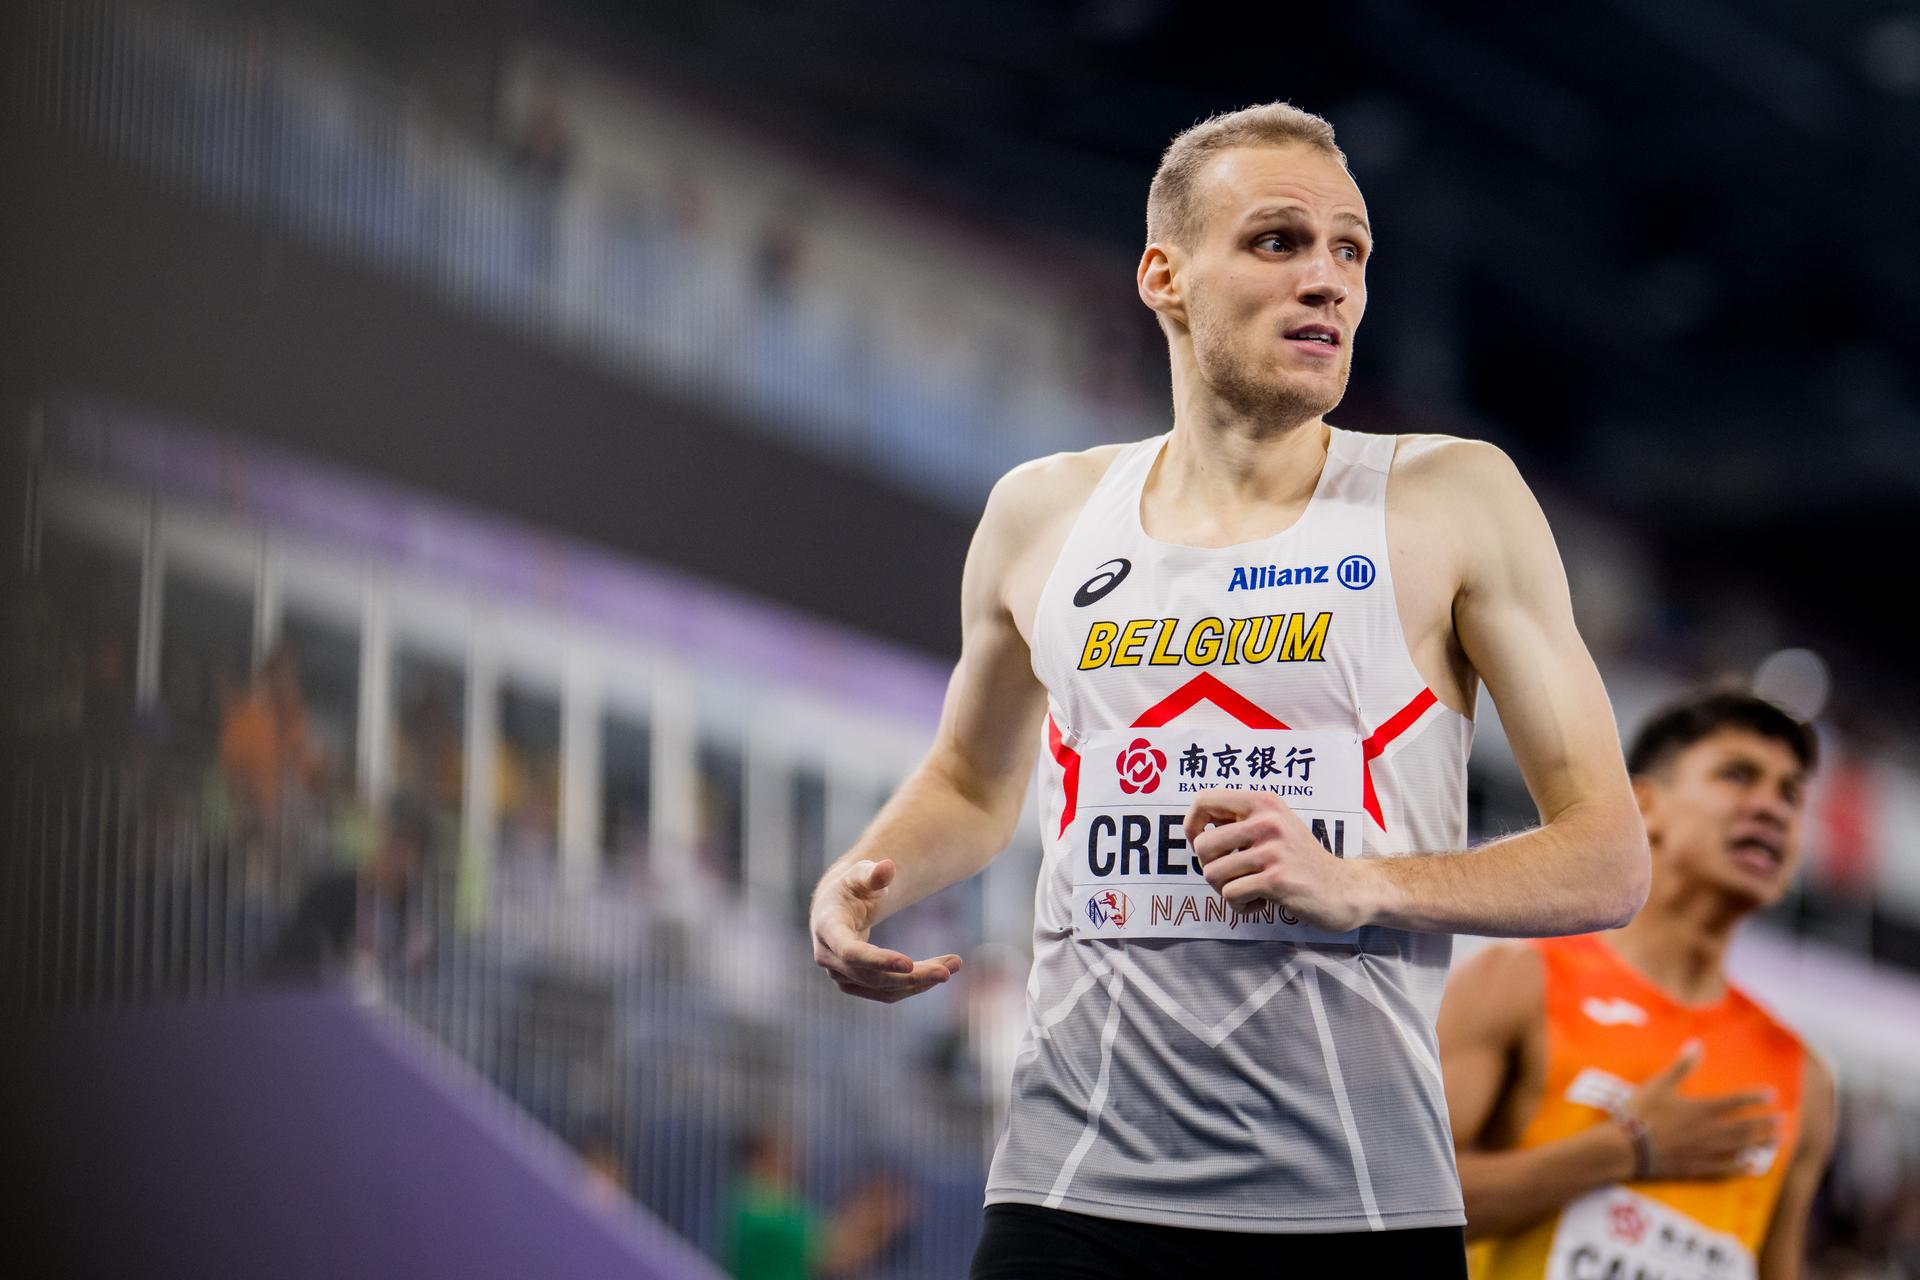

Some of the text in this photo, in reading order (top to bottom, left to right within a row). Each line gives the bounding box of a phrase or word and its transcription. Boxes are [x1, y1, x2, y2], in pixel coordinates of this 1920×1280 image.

[1228, 564, 1329, 591] Allianz
[1076, 611, 1333, 671] BELGIUM
[1178, 742, 1316, 781] 南京银行
[1249, 784, 1313, 796] NANJING
